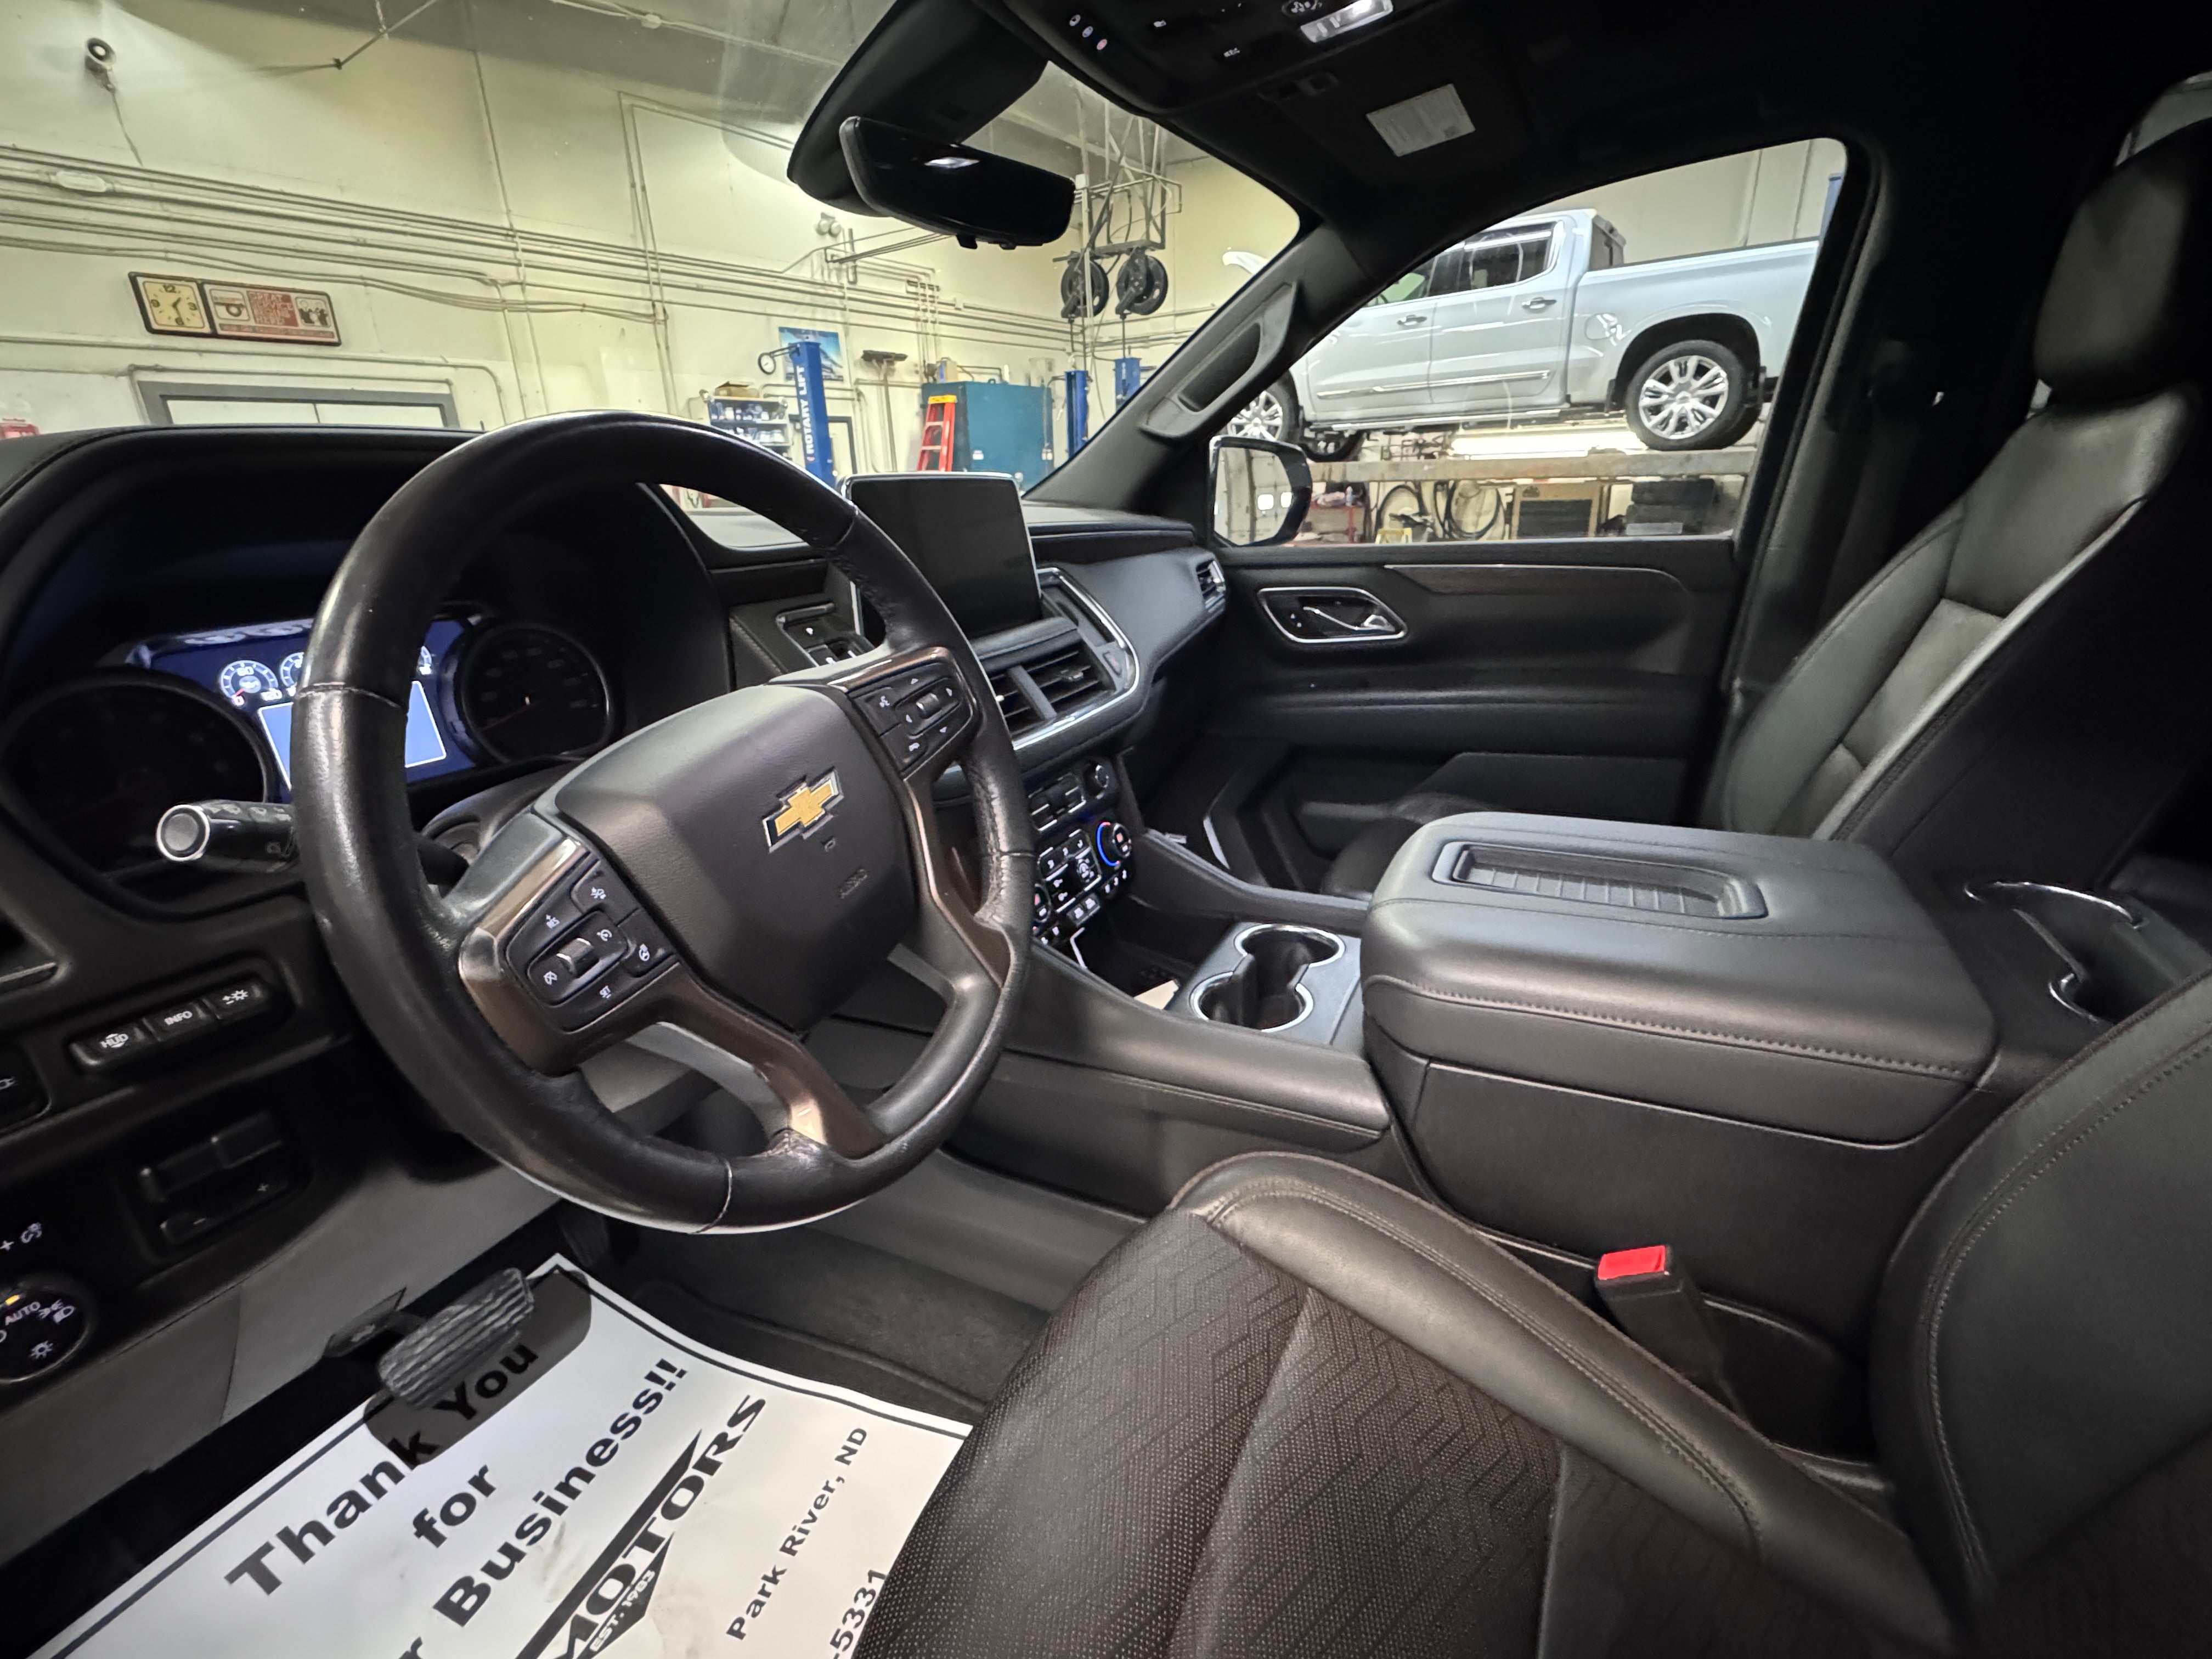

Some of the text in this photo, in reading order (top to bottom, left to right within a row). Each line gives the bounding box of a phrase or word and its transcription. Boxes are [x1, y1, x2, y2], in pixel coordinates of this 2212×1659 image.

[162, 284, 177, 293] 12
[150, 299, 160, 308] 9
[188, 302, 197, 311] 3
[175, 317, 184, 325] 6
[797, 366, 815, 454] ROTARY LIFT
[232, 695, 245, 706] 0
[165, 1010, 193, 1025] INFO
[101, 1033, 129, 1048] HUD
[5, 1301, 41, 1326] AUTO
[225, 1344, 538, 1596] Thank You
[432, 1358, 688, 1627] Business!!
[412, 1464, 498, 1549] for
[726, 1427, 868, 1641] Park River, ND
